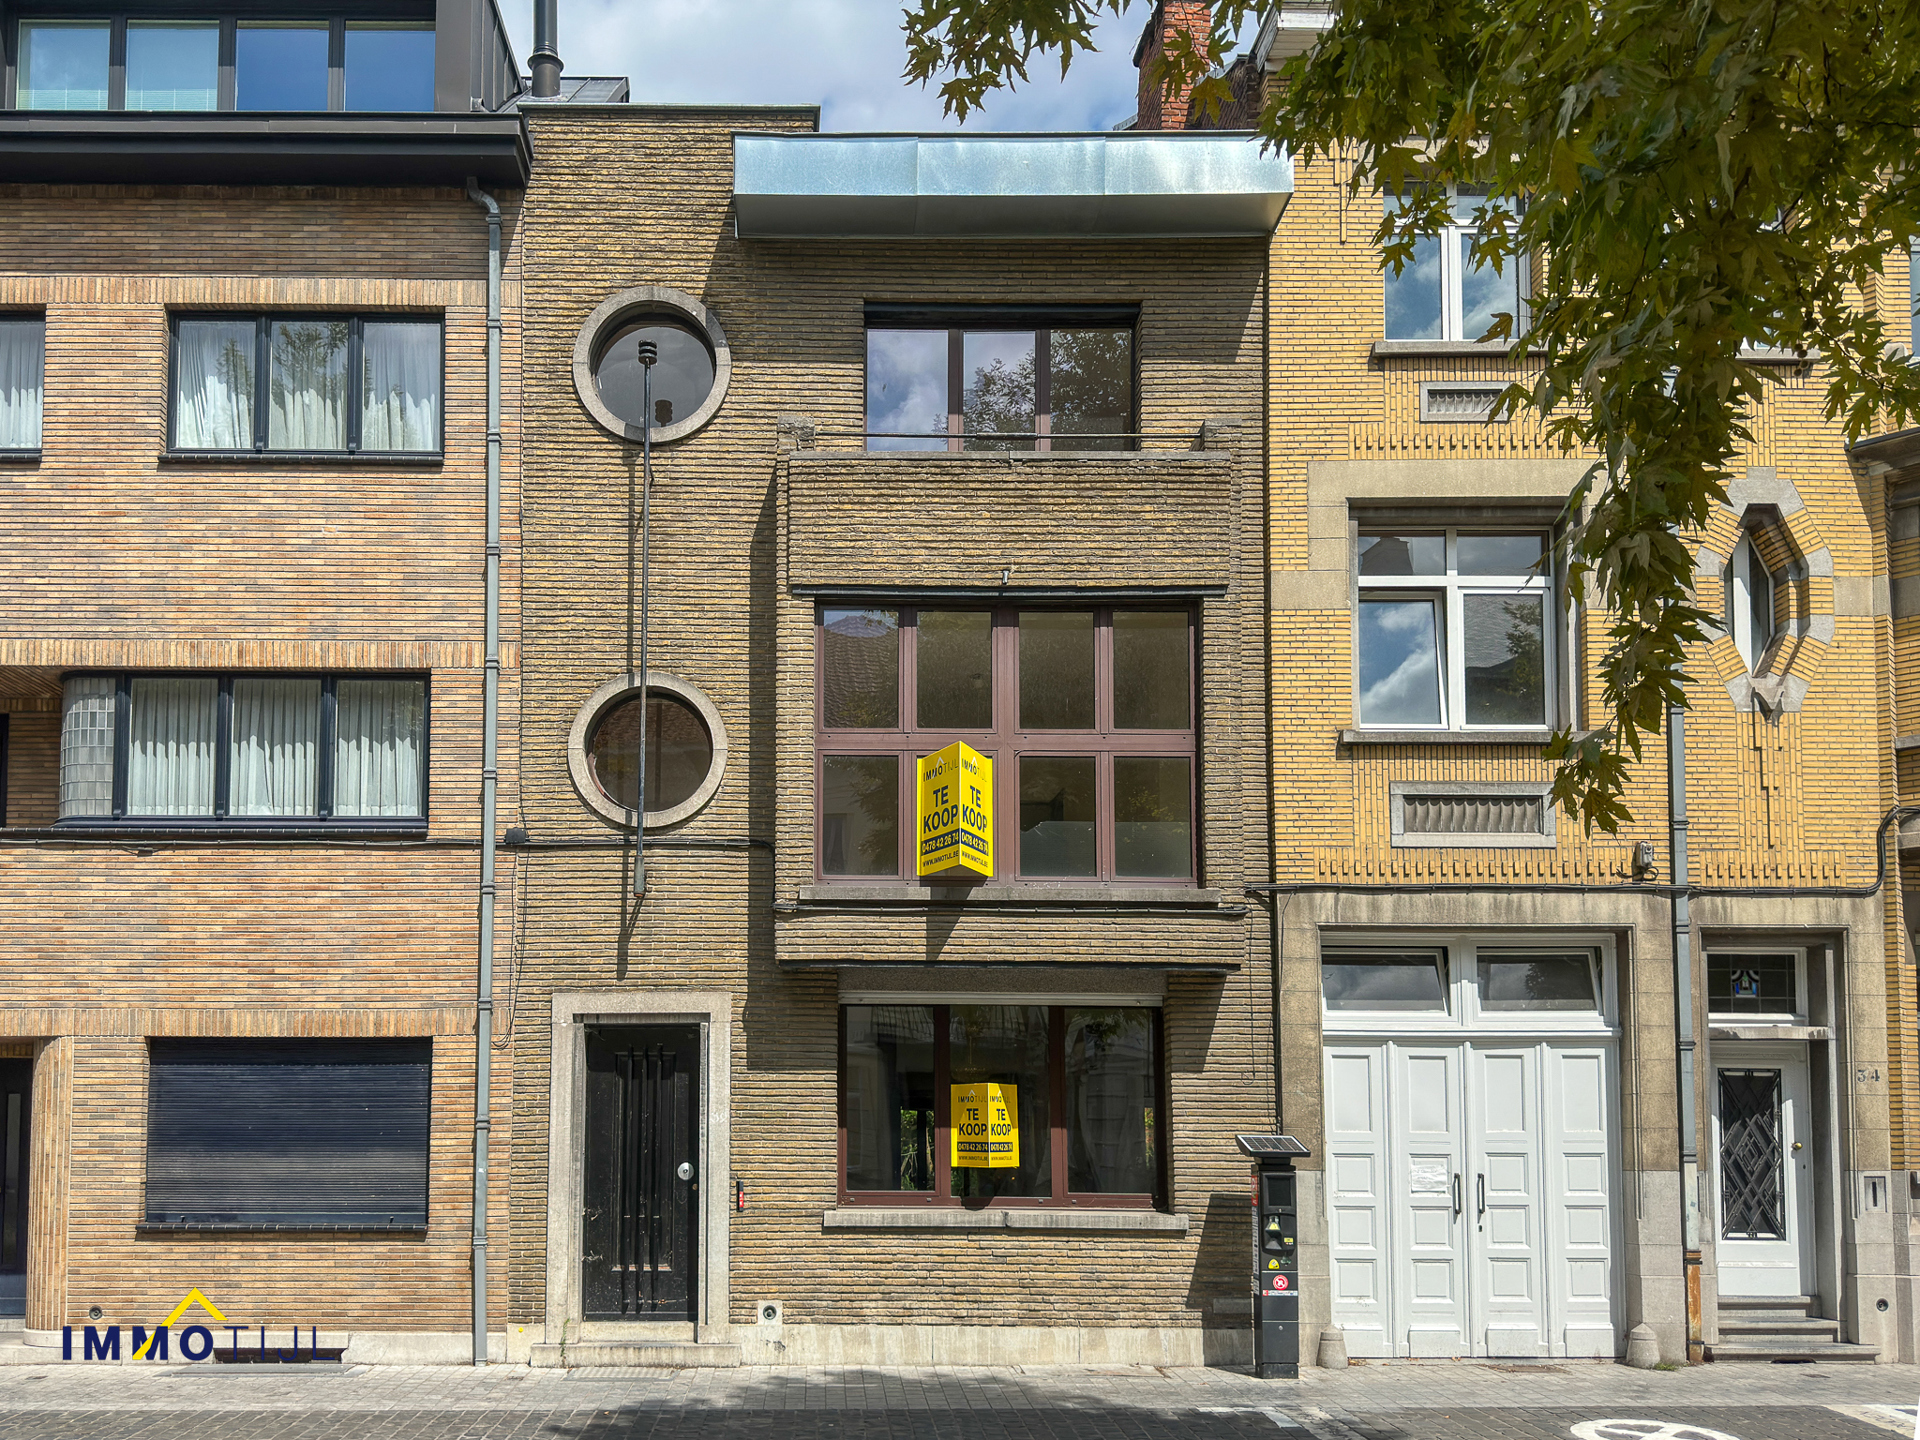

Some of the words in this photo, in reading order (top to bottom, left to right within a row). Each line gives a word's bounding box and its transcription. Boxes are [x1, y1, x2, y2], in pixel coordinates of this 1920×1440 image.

[933, 785, 949, 807] TE
[970, 785, 982, 808] TE
[923, 804, 959, 834] KOOP
[962, 803, 988, 833] KOOP
[937, 837, 944, 848] 42
[945, 834, 952, 846] 26
[952, 831, 959, 843] 74
[1857, 1069, 1880, 1082] 34
[966, 1108, 979, 1121] TE
[996, 1108, 1006, 1121] TE
[959, 1123, 987, 1136] KOOP
[991, 1123, 1012, 1136] KOOP
